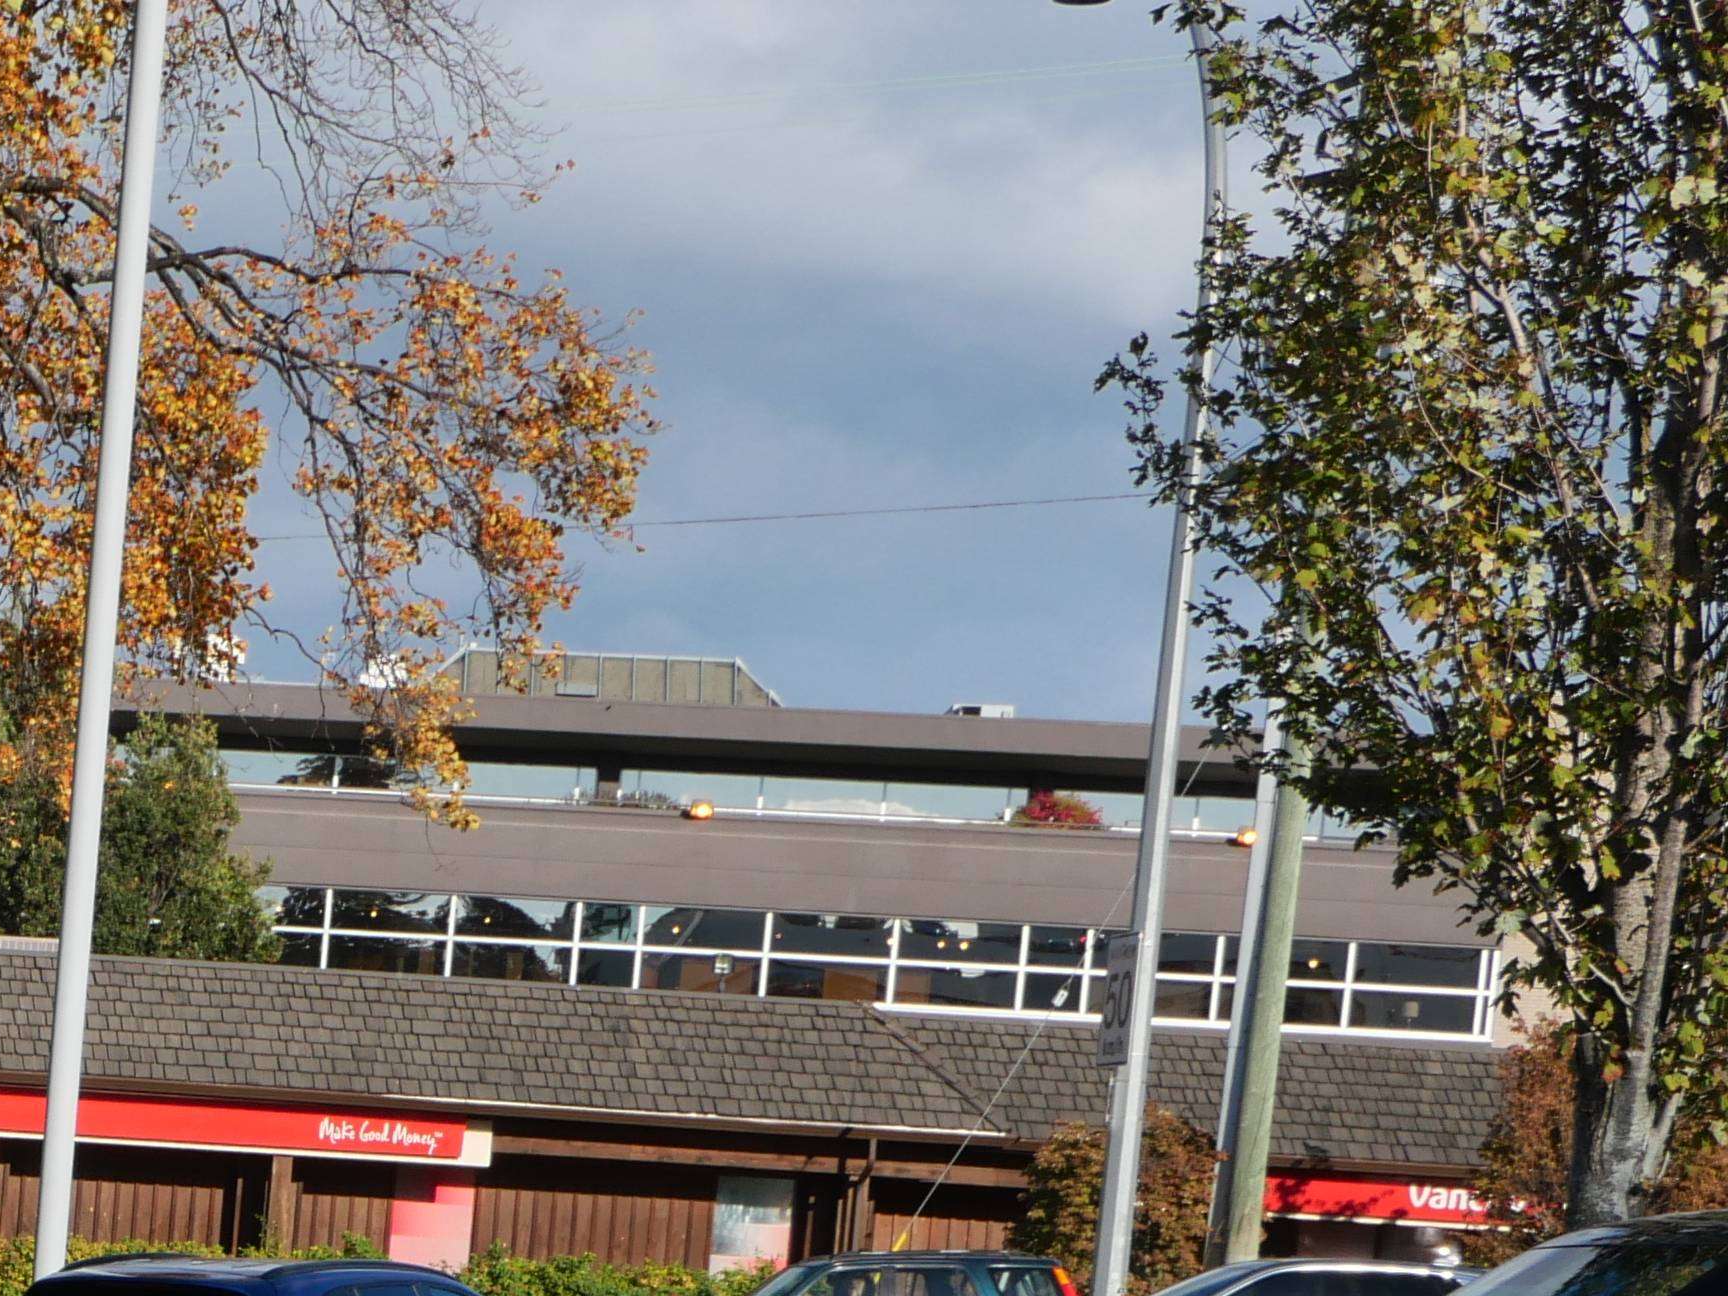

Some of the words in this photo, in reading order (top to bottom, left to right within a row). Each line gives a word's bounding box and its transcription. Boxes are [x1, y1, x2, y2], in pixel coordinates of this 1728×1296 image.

[1105, 970, 1132, 1030] 50
[318, 1115, 356, 1144] Make
[359, 1120, 391, 1143] Good
